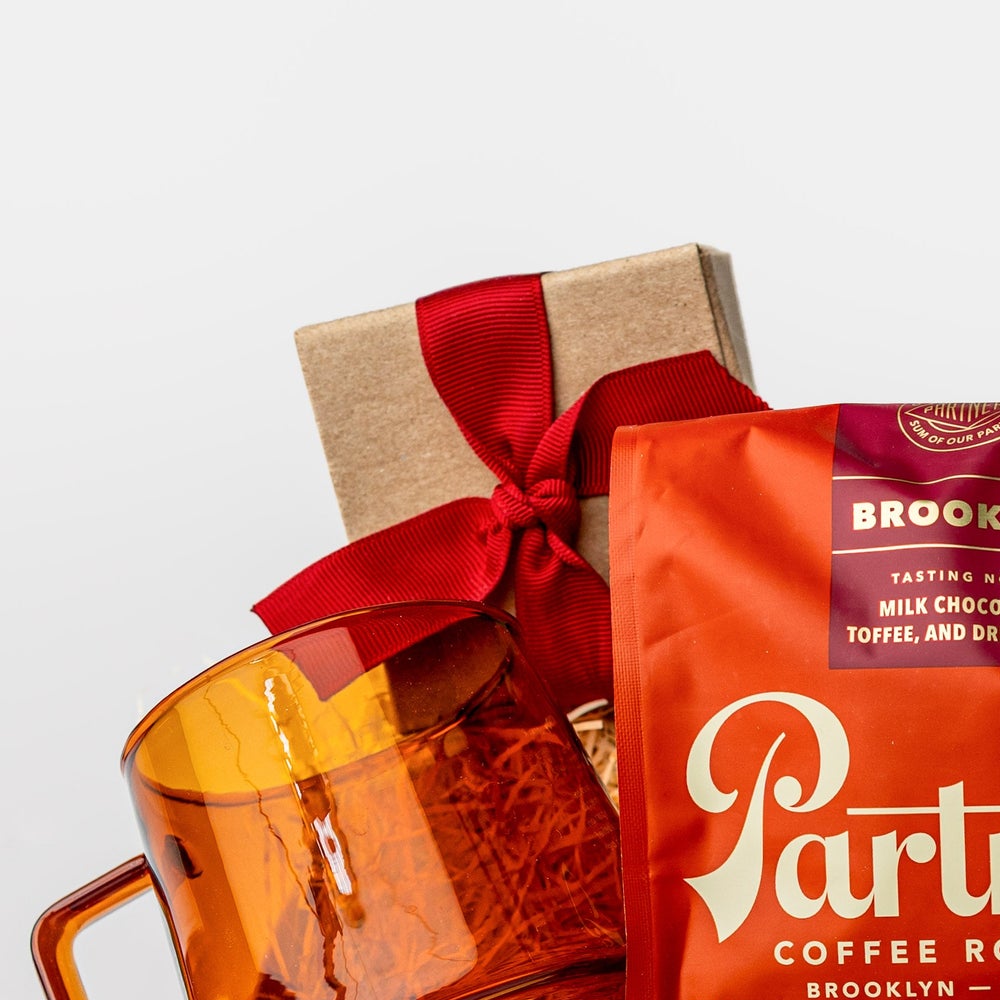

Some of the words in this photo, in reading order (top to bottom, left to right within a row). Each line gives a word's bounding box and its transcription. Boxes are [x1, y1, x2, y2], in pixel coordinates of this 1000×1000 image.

[909, 420, 929, 439] SUM
[928, 435, 945, 445] OF
[946, 434, 973, 445] OUR
[891, 570, 973, 584] TASTING
[879, 597, 928, 617] MILK
[847, 625, 920, 644] TOFFEE,
[925, 624, 966, 641] AND
[773, 939, 938, 966] COFFEE
[807, 980, 956, 999] BROOKLYN
